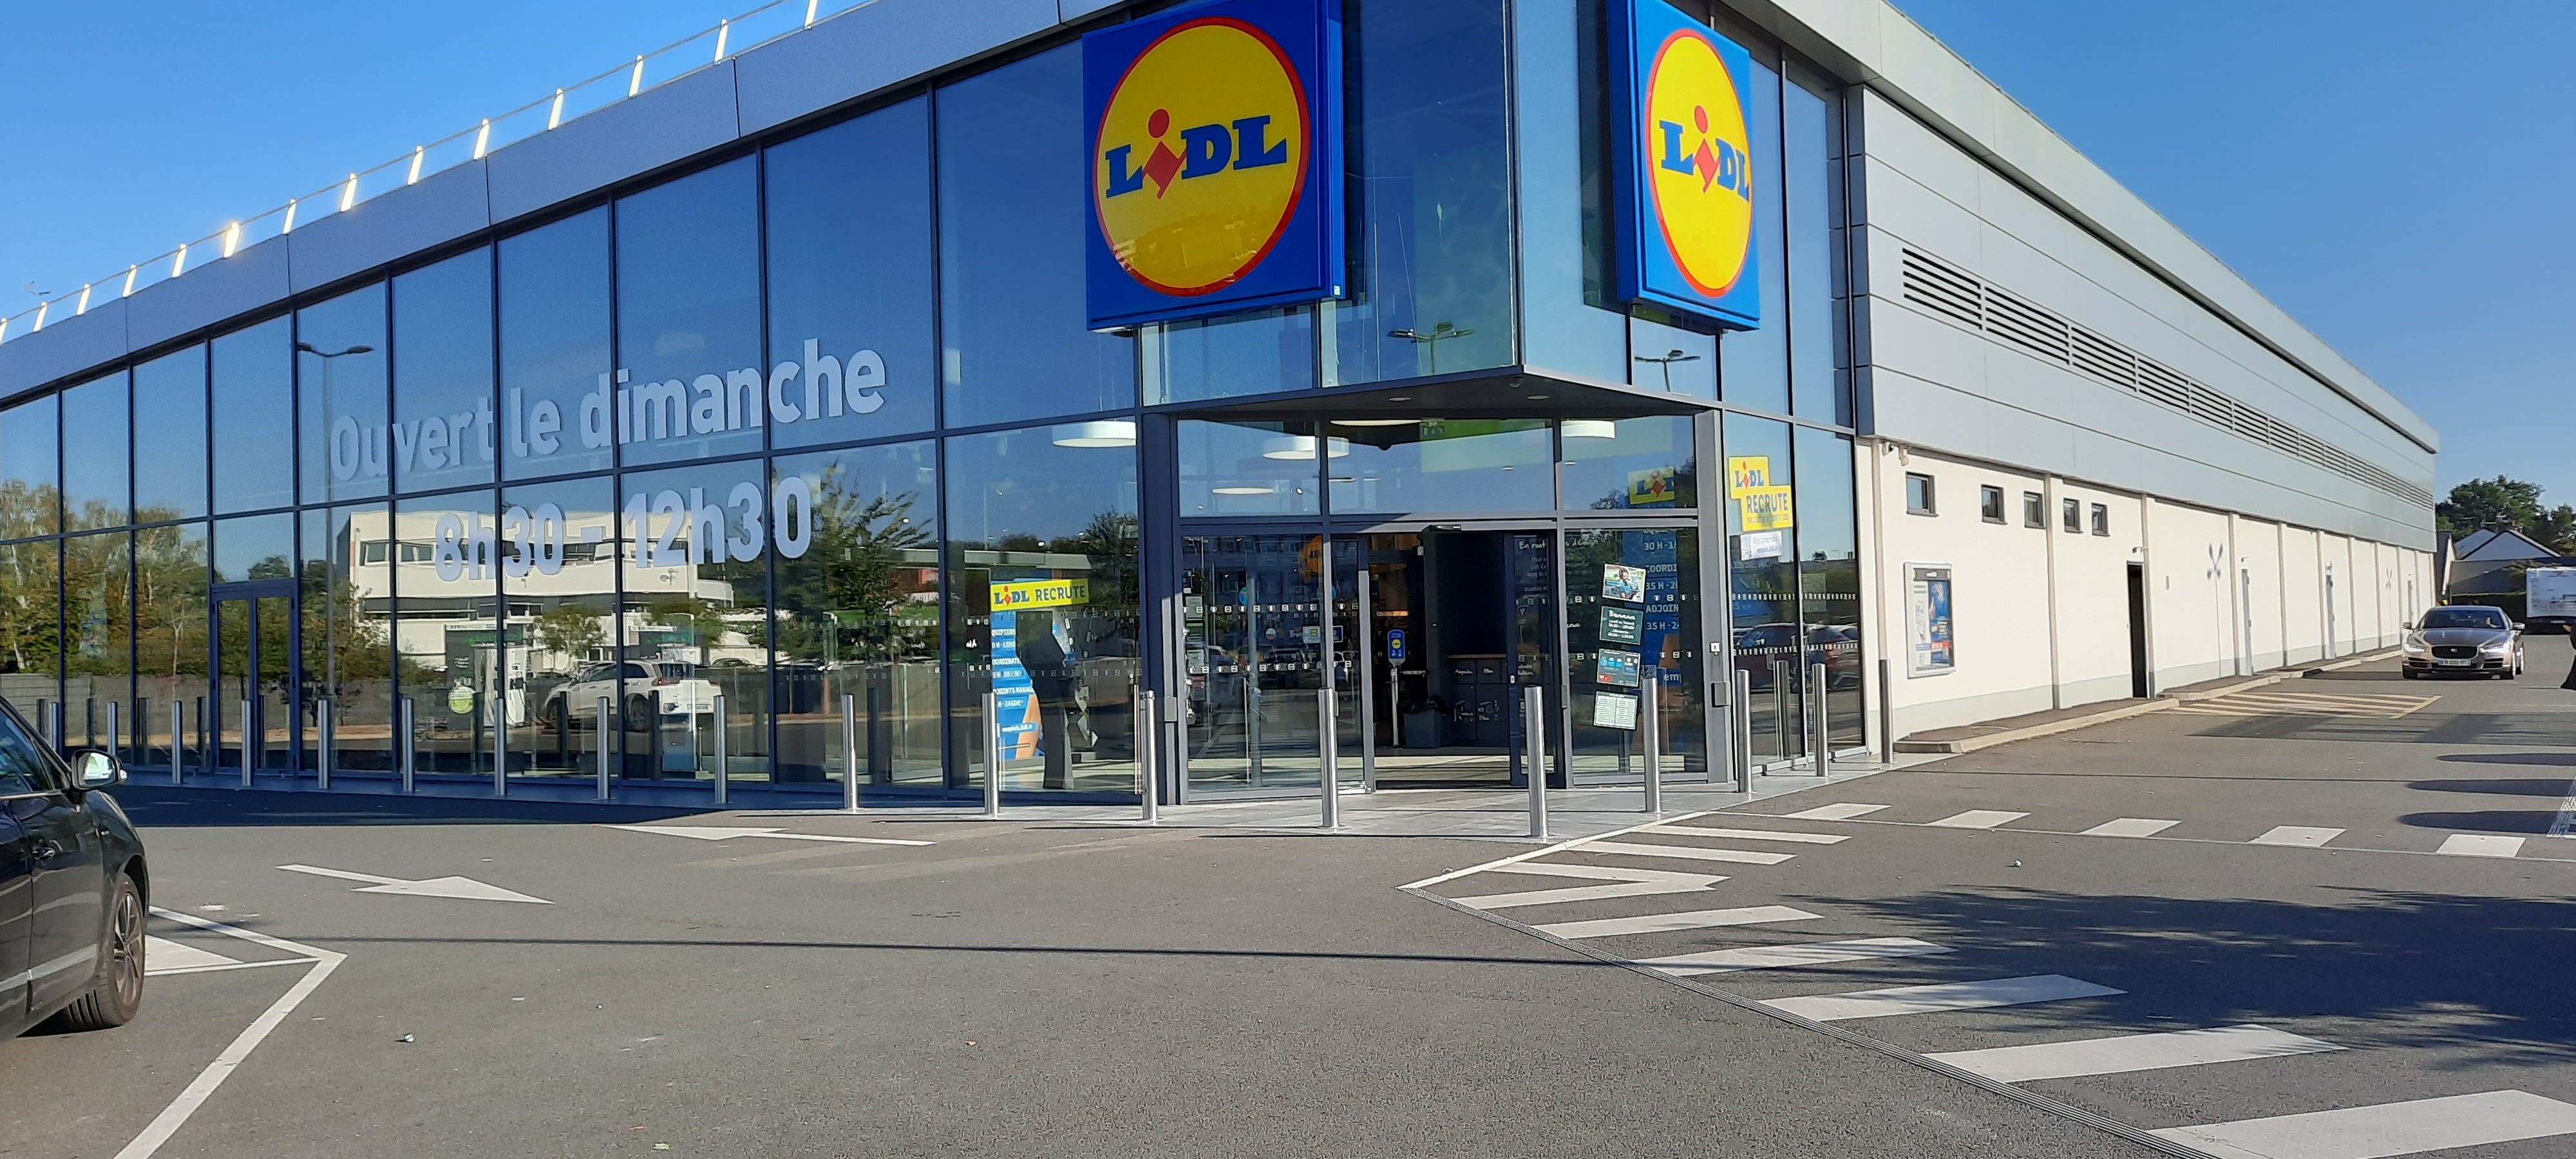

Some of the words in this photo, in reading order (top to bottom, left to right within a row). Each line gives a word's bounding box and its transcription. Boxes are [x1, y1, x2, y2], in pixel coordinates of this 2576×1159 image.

[330, 396, 495, 482] Ouvert
[509, 387, 562, 457] le
[580, 338, 886, 449] dimanche
[1746, 493, 1788, 514] RECRUTE
[435, 502, 564, 582] 8h30
[623, 476, 811, 569] 12h30
[1643, 542, 1655, 551] 30
[1646, 582, 1656, 591] 35
[1035, 585, 1086, 601] RECRUTE
[1645, 604, 1679, 613] ADJOIN
[1646, 622, 1658, 630] 35
[1659, 621, 1665, 630] H
